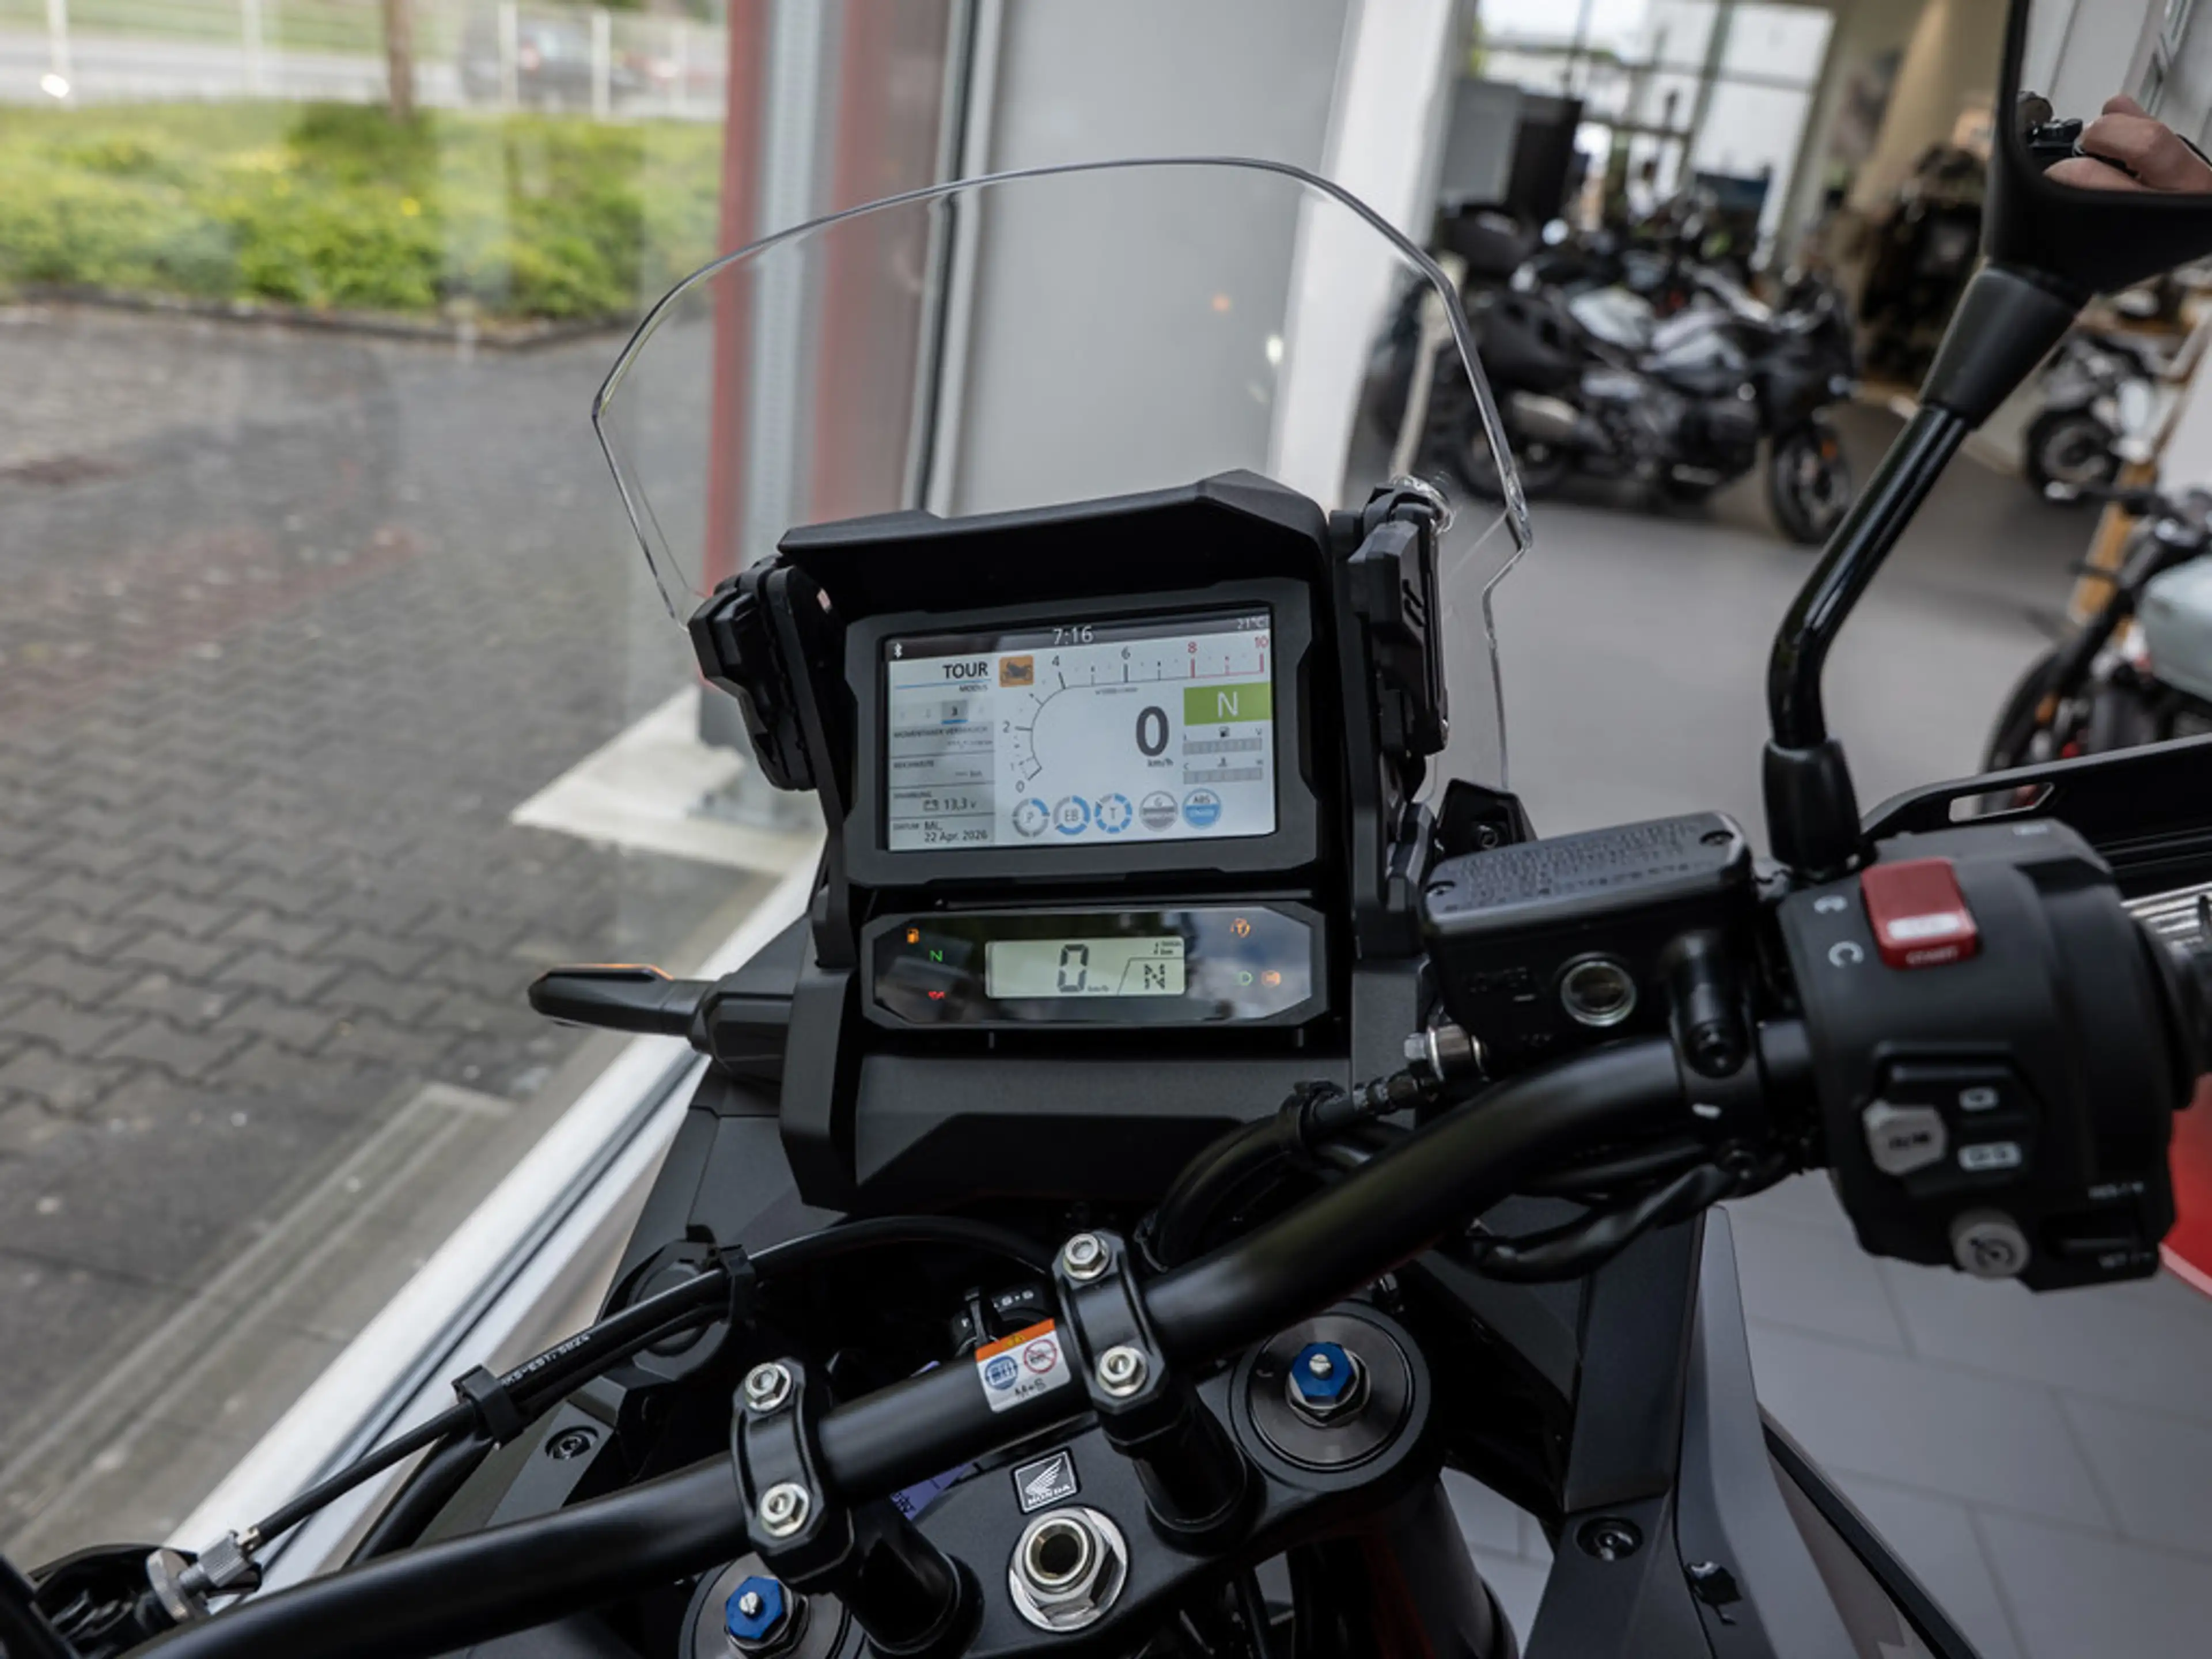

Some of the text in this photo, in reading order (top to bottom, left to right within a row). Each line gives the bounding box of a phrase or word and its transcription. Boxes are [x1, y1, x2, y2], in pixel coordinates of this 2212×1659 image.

[1054, 626, 1093, 645] 7:16
[1255, 635, 1269, 649] 10
[1121, 646, 1130, 660] 6
[1188, 641, 1197, 653] 8
[1052, 655, 1060, 666] 4
[942, 661, 988, 679] TOUR
[1217, 691, 1238, 718] N
[1002, 721, 1010, 733] 2
[1136, 706, 1169, 757] 0
[1147, 757, 1174, 768] km/h
[1015, 779, 1025, 793] 0
[1064, 808, 1079, 822] EB
[929, 950, 943, 963] N
[1057, 944, 1089, 992] 0
[1144, 963, 1165, 990] N
[1028, 1484, 1070, 1505] HONDA
